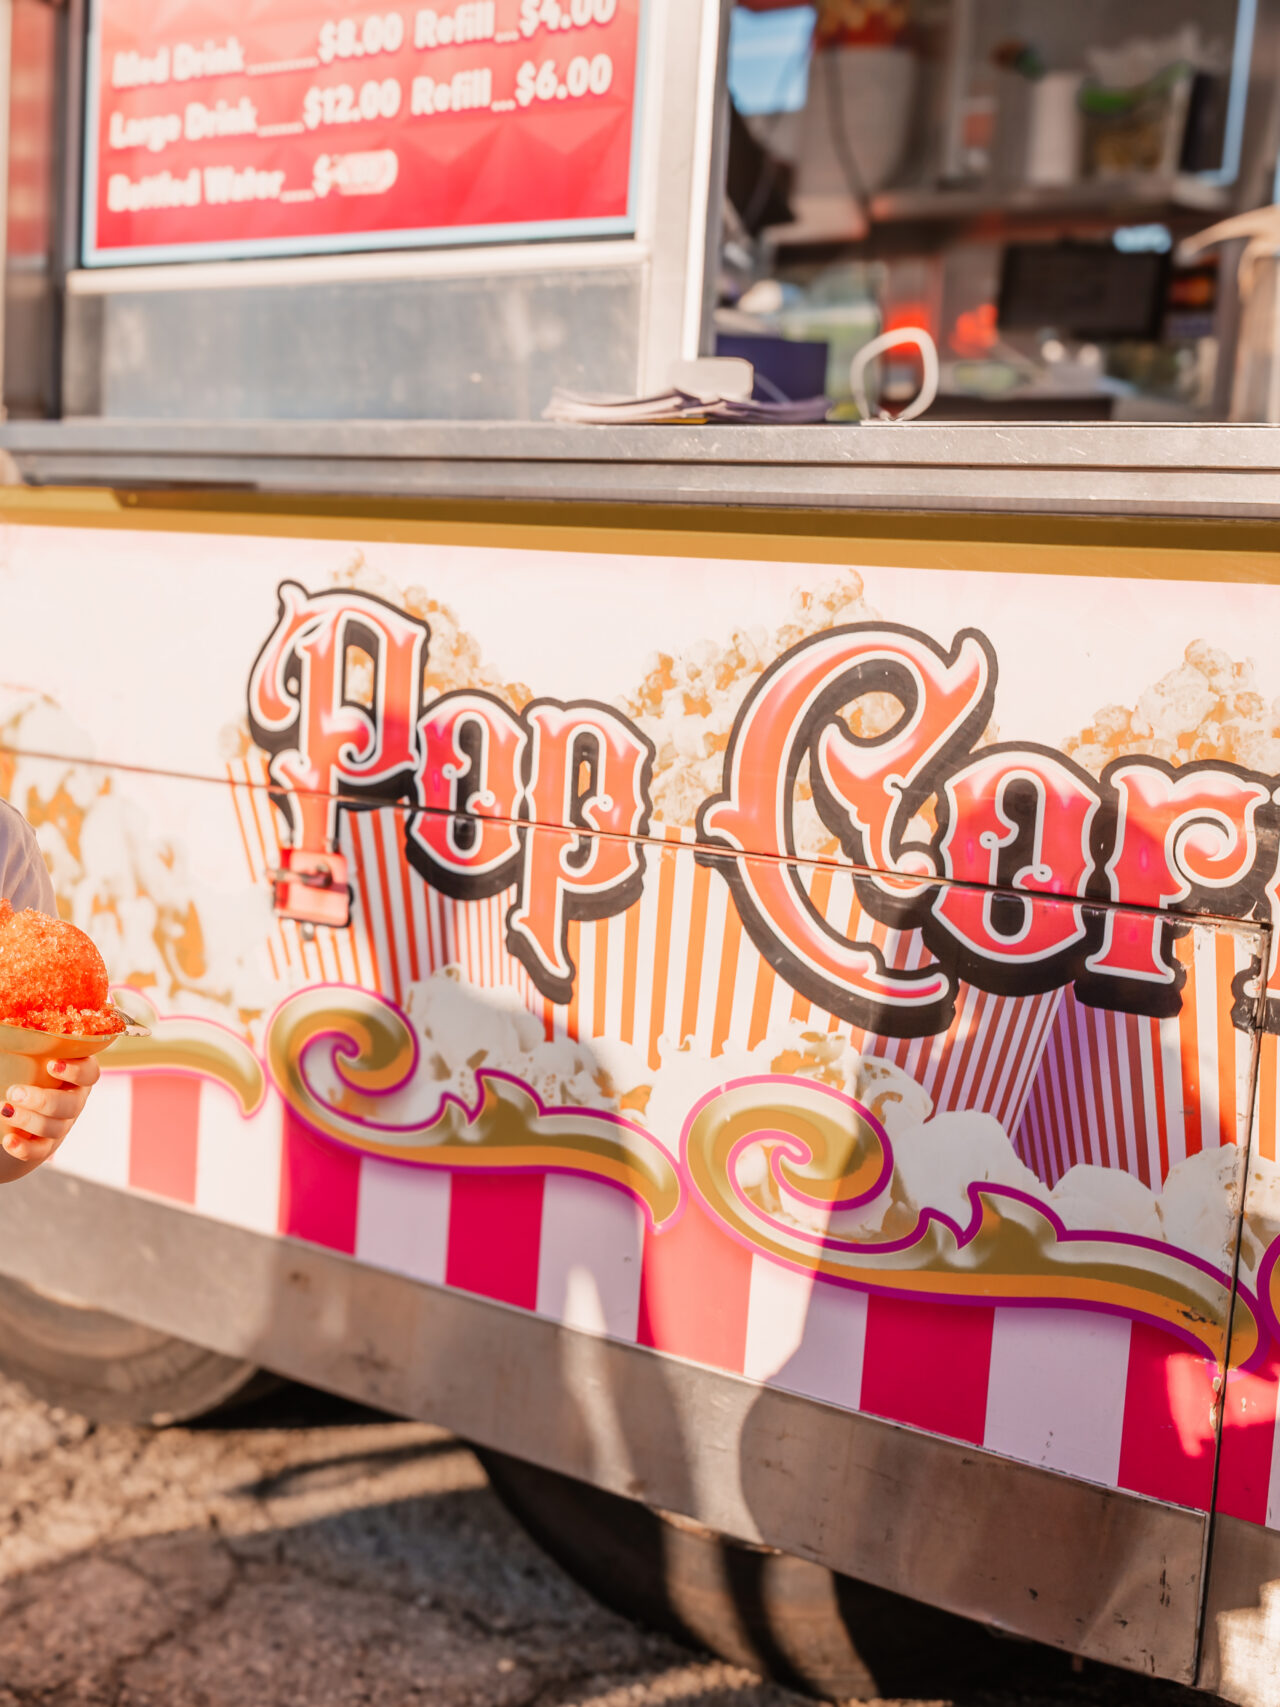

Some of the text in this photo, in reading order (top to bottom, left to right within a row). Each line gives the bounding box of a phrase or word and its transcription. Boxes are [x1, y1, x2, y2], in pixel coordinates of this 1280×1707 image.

[109, 112, 181, 151] Large
[107, 167, 201, 212] Bottled
[249, 580, 1280, 1038] Pop Cor
